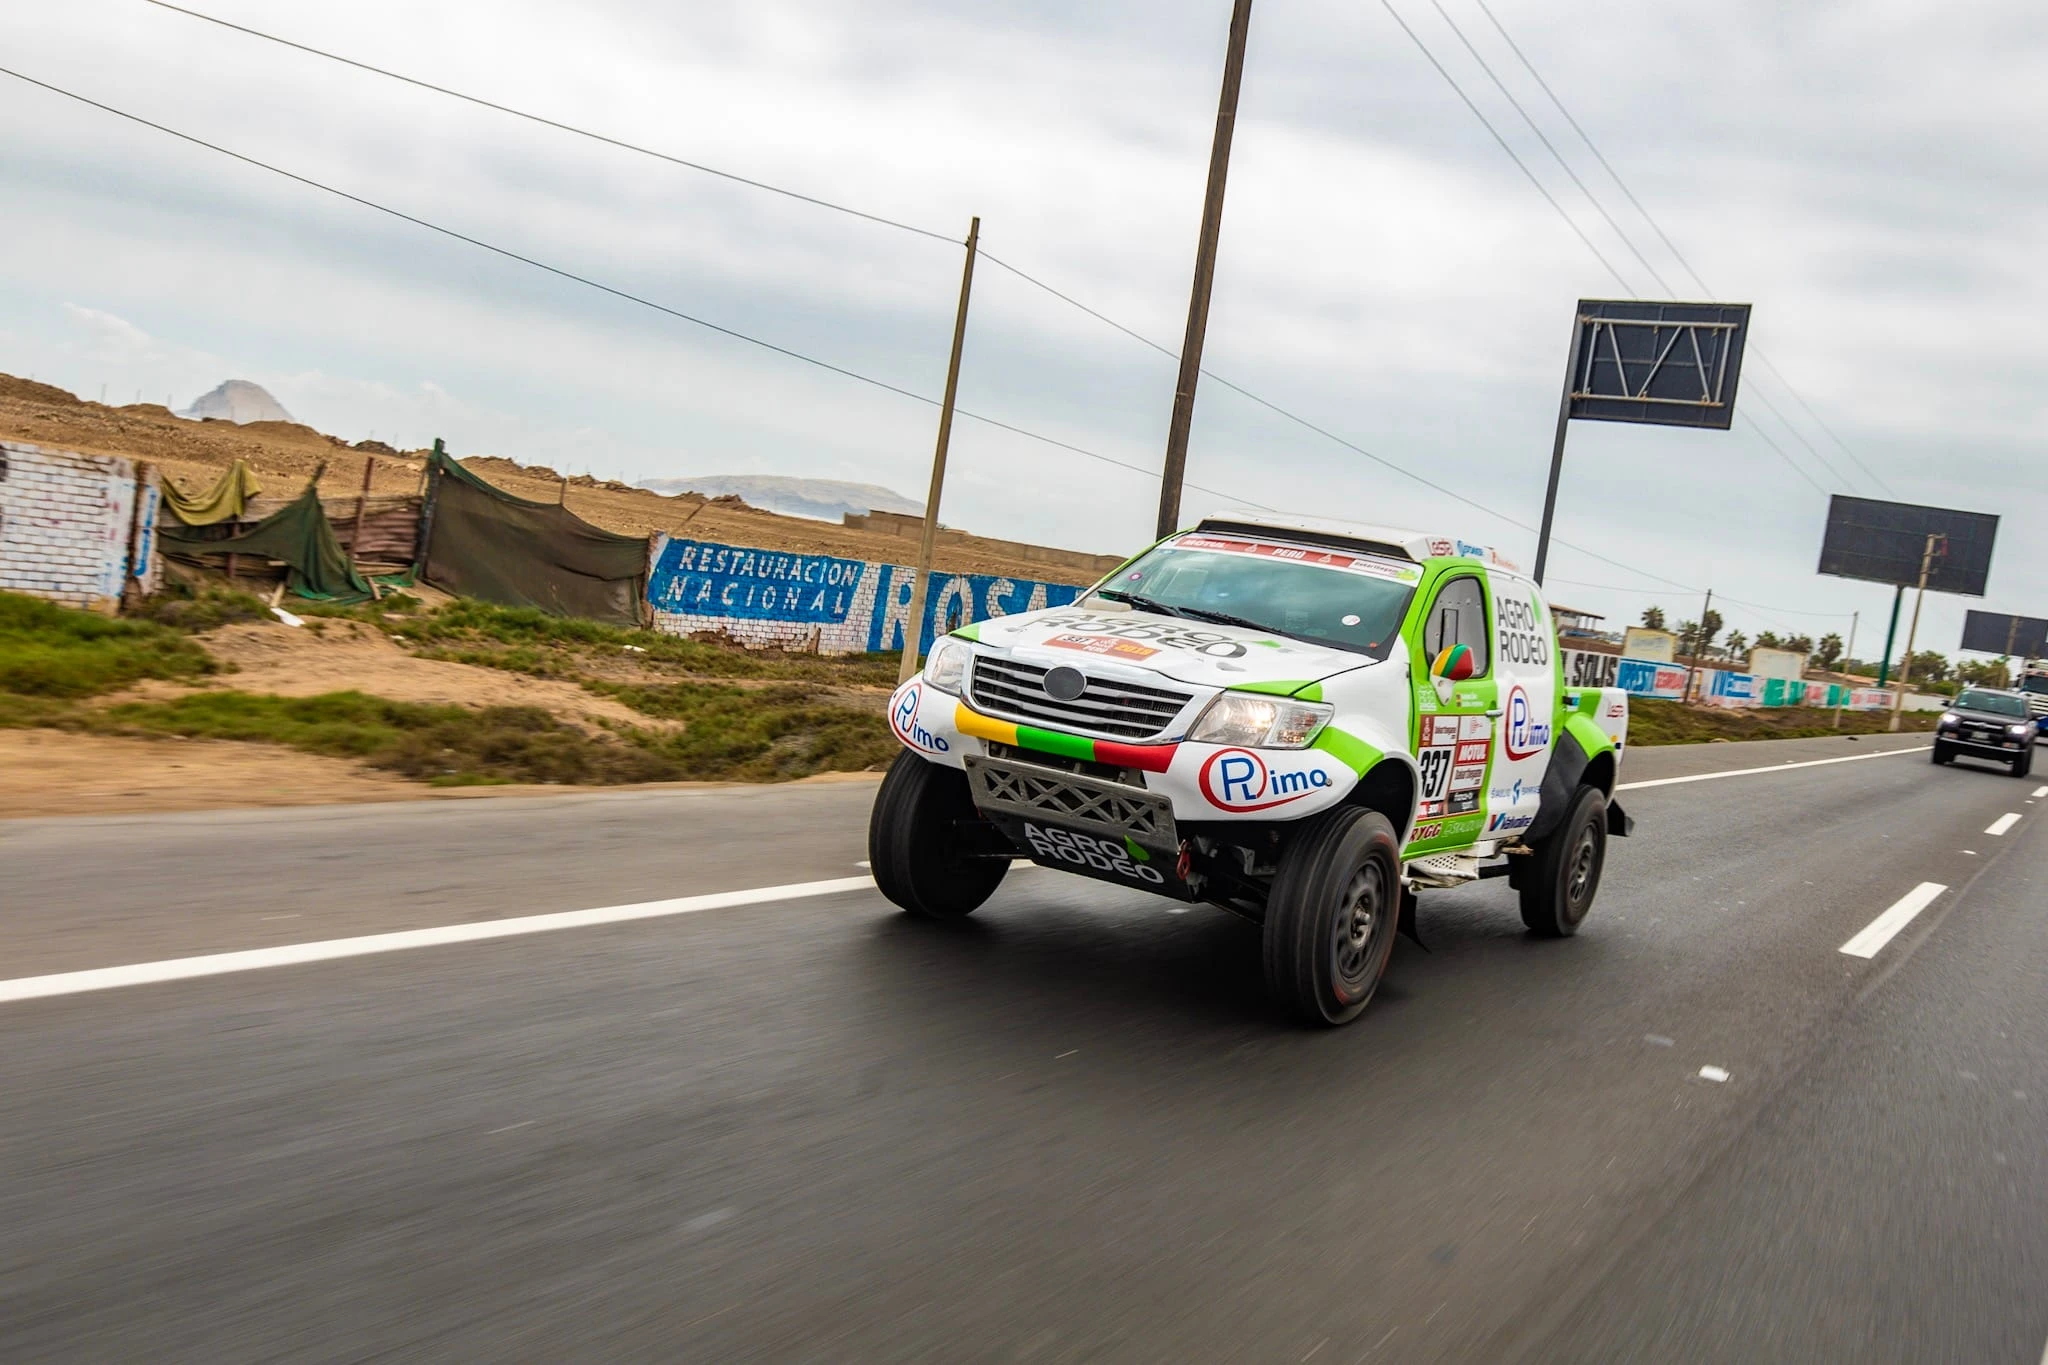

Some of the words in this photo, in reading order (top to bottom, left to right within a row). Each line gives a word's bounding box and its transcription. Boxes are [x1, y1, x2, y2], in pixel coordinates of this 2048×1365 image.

[679, 546, 858, 586] RESTAURACION
[666, 575, 844, 615] NACIONAL
[1496, 596, 1535, 632] AGRO
[1499, 630, 1548, 666] RODEO
[1572, 652, 1618, 688] SOLIS
[1459, 743, 1487, 761] MOTUL
[1025, 822, 1128, 859] AGRO
[1029, 838, 1164, 884] RODEO
